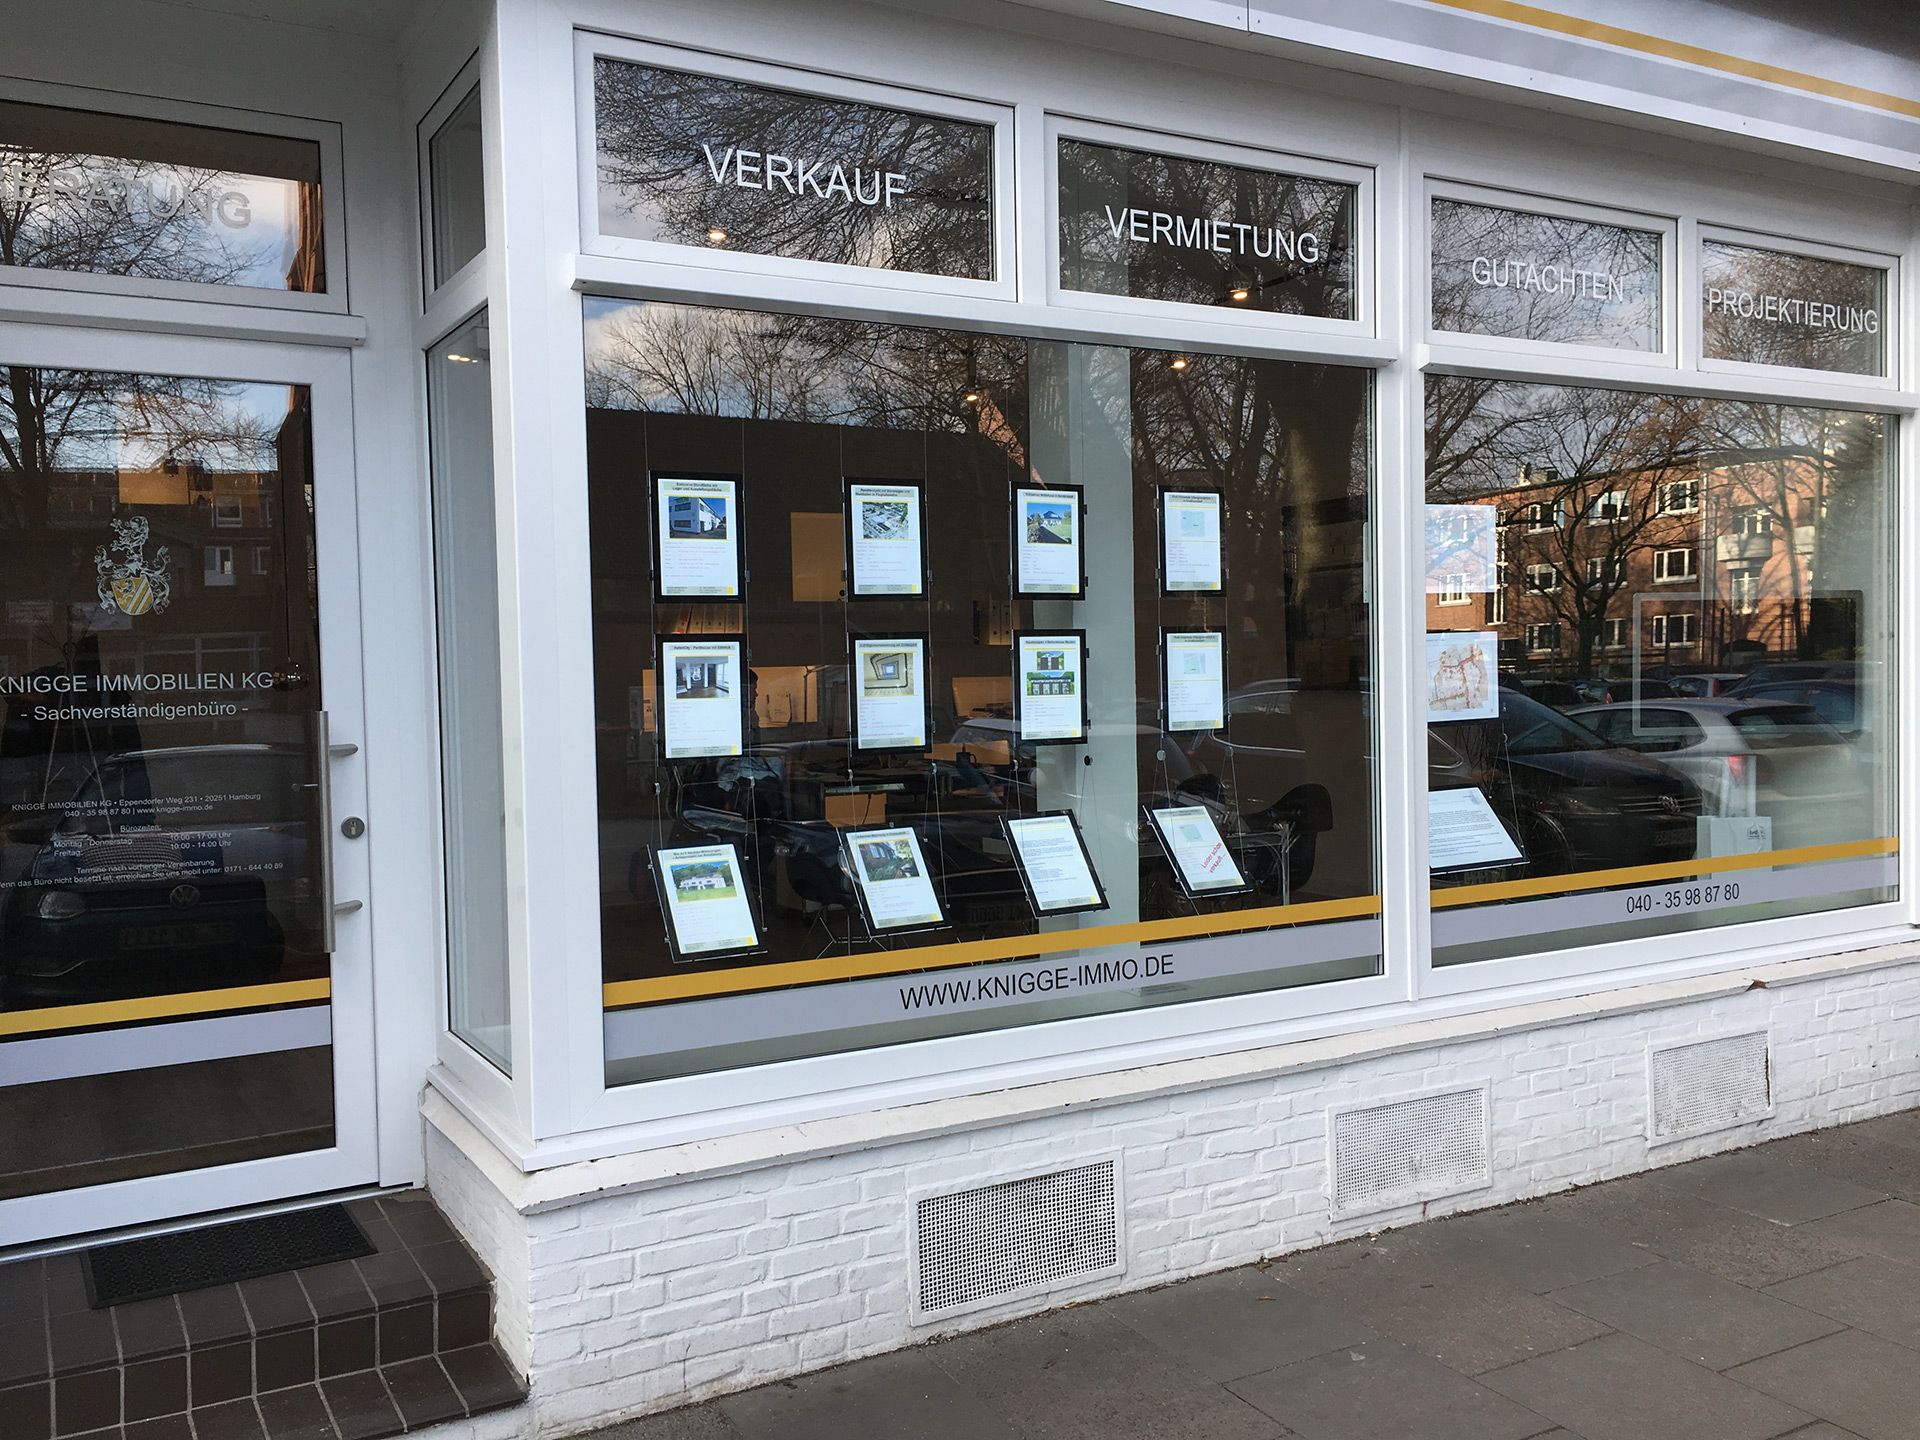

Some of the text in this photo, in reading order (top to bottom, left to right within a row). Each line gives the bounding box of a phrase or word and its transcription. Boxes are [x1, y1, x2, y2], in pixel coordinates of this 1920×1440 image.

[703, 144, 907, 207] VERKAUF
[0, 166, 251, 229] ERATUNG
[1105, 205, 1319, 264] VERMIETUNG
[1472, 256, 1624, 302] GUTACHTEN
[1708, 287, 1878, 334] PROJEKTIERUNG
[97, 672, 234, 692] IMMOBILIEN
[242, 672, 273, 689] KG
[34, 702, 237, 721] Sachverständigenbüro
[11, 803, 46, 811] KNIGGE
[47, 801, 98, 809] IMMOBILIEN
[100, 799, 112, 808] KG
[119, 798, 164, 807] Eppendorfer
[166, 796, 183, 805] Weg
[228, 793, 261, 801] Hamburg
[65, 809, 80, 818] 040
[98, 808, 108, 816] 98
[109, 808, 119, 816] 87
[121, 807, 131, 815] 80
[136, 804, 213, 814] www.knigge-immo.de
[0, 880, 16, 889] enn
[34, 878, 52, 886] Büro
[224, 864, 242, 872] 0171
[1626, 894, 1652, 914] 040
[1665, 890, 1681, 909] 35
[1685, 888, 1701, 906] 98
[1705, 885, 1720, 903] 87
[1724, 883, 1740, 901] 80
[900, 953, 1175, 1010] WWW.KNIGGE-IMMO.DE
